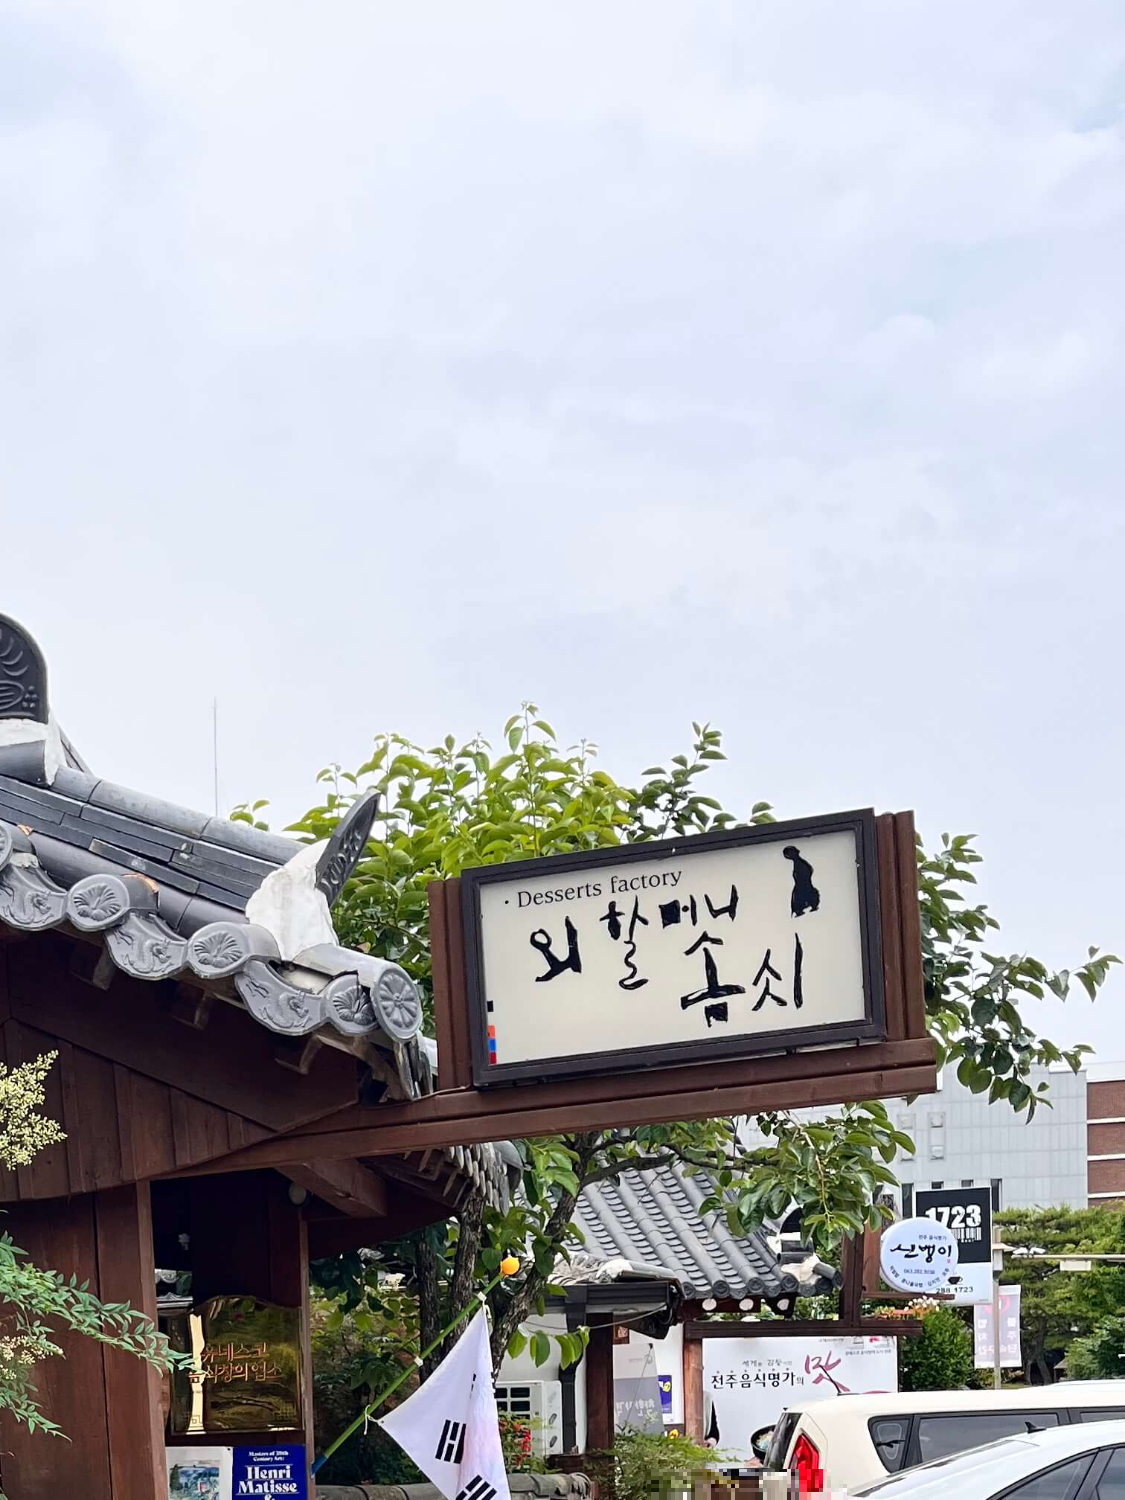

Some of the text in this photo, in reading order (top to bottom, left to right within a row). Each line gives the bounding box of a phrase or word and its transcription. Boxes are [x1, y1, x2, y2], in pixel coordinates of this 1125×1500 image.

[518, 870, 683, 908] Desserts factory
[529, 884, 740, 990] 외할머니
[925, 1204, 982, 1229] 1723
[889, 1243, 952, 1263] 신뱅이
[200, 1341, 270, 1363] 유네스코
[246, 1464, 291, 1480] Henri
[238, 1480, 298, 1494] Matisse
